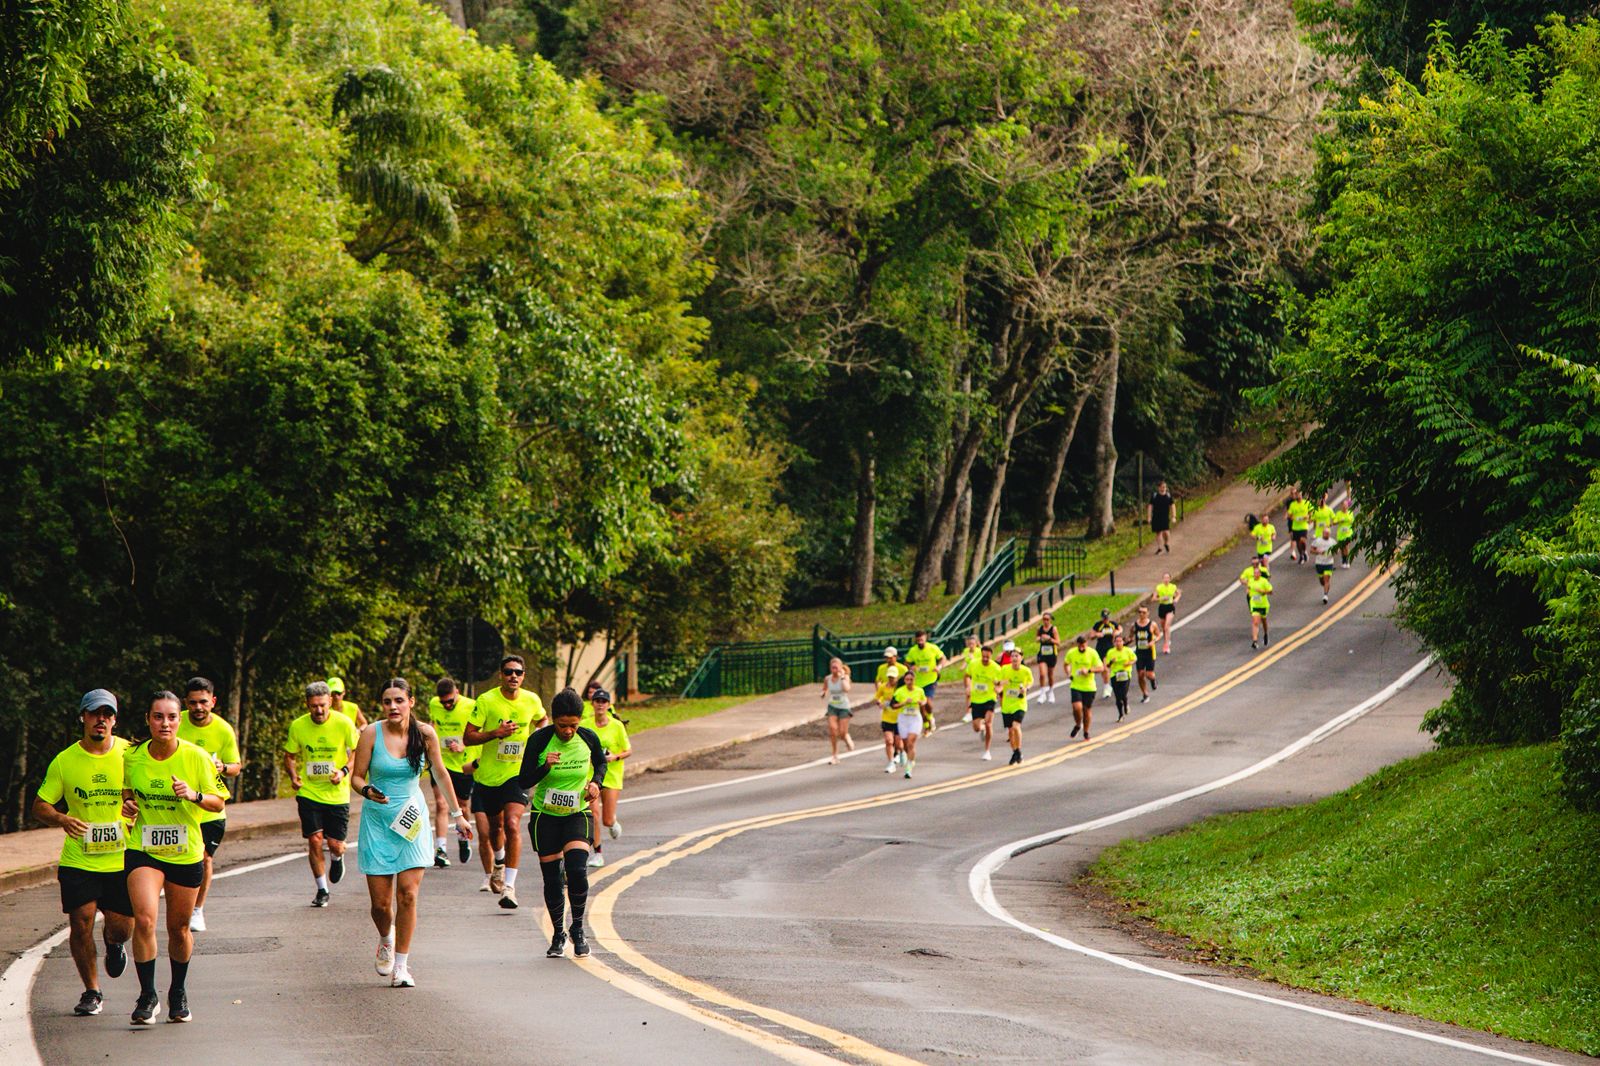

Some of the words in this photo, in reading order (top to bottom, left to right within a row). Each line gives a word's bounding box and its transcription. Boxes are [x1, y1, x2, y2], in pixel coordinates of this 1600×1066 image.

[504, 744, 520, 755] 8751
[313, 764, 329, 775] 8215
[551, 793, 574, 807] 9596
[399, 805, 420, 830] 8186
[92, 827, 117, 842] 8753
[151, 829, 178, 846] 8765
